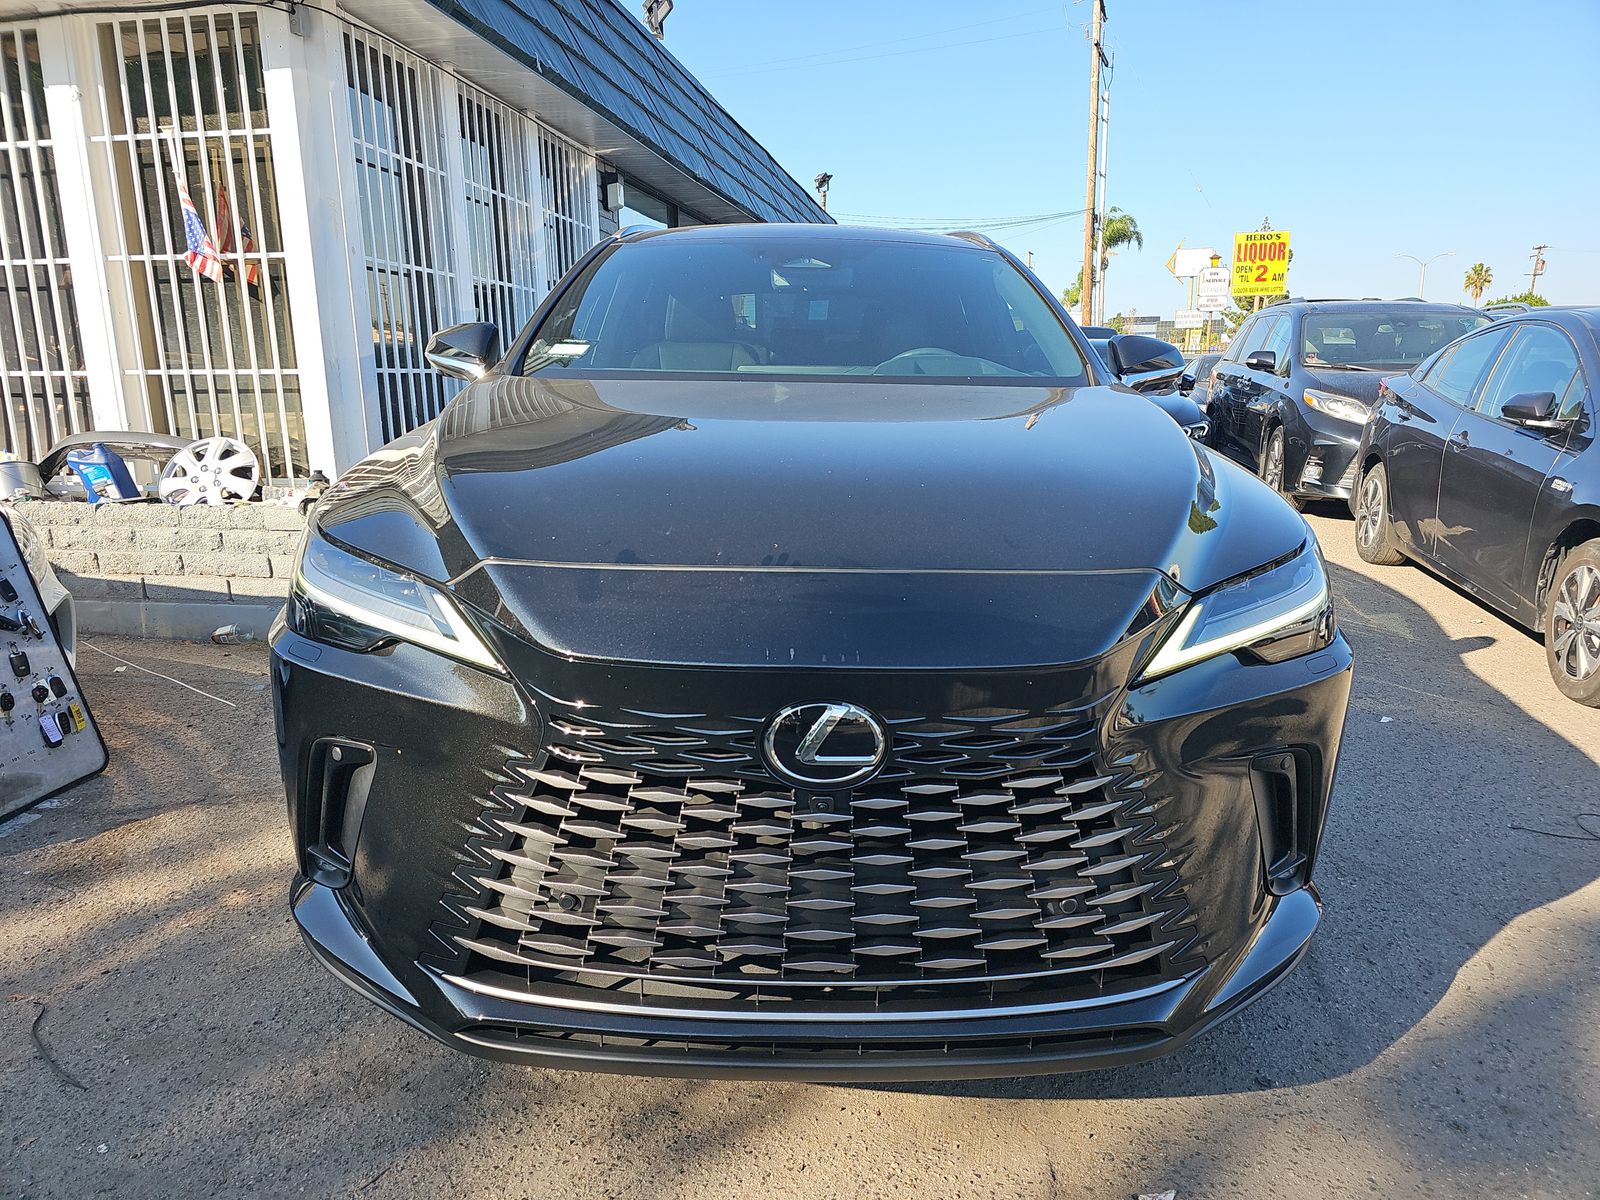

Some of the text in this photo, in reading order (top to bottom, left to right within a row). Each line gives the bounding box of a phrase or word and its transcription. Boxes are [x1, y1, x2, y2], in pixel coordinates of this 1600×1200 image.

[1246, 233, 1281, 241] HERO'S
[1236, 242, 1287, 264] LIQUOR
[1235, 265, 1253, 274] OPEN
[1254, 264, 1269, 283] 2
[1271, 273, 1285, 282] AM
